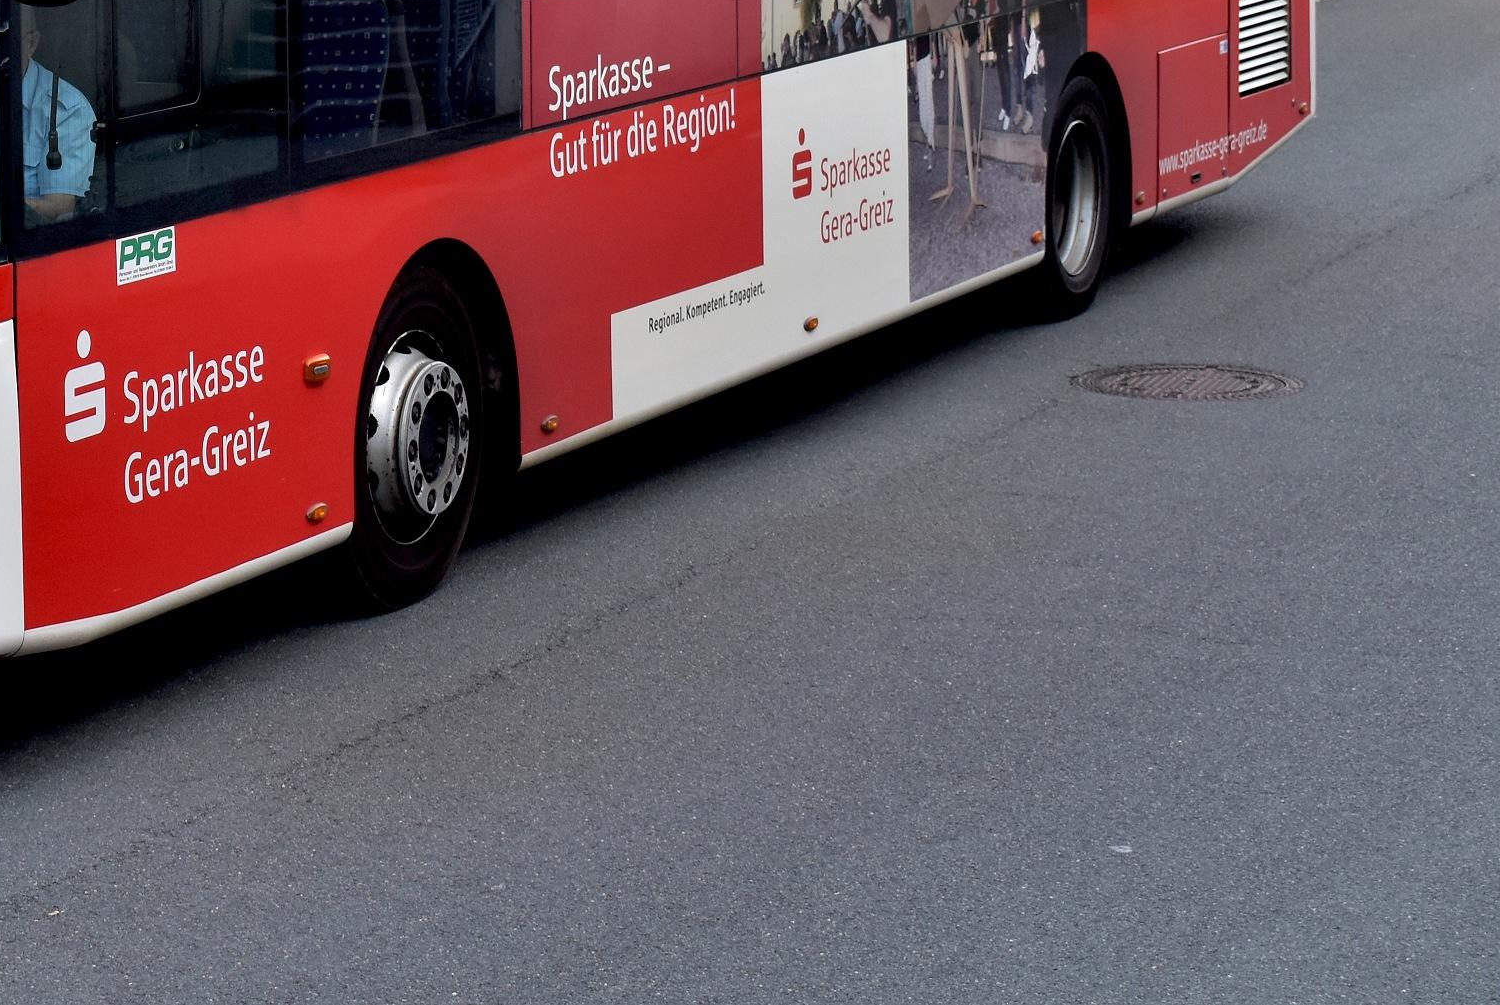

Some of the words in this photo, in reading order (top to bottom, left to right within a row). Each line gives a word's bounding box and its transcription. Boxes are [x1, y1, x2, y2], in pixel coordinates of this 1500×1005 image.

[548, 54, 653, 121] Sparkasse
[550, 130, 588, 179] Gut
[592, 120, 621, 167] für
[627, 106, 657, 157] die
[664, 88, 736, 153] Region!
[820, 147, 891, 198] Sparkasse
[820, 191, 894, 244] Gera-Greiz
[119, 229, 173, 270] PRG
[648, 307, 685, 334] Regional.
[685, 293, 728, 319] Kompetent.
[729, 281, 765, 306] Engagiert.
[122, 345, 264, 432] Sparkasse
[124, 411, 271, 504] Gera-Greiz
